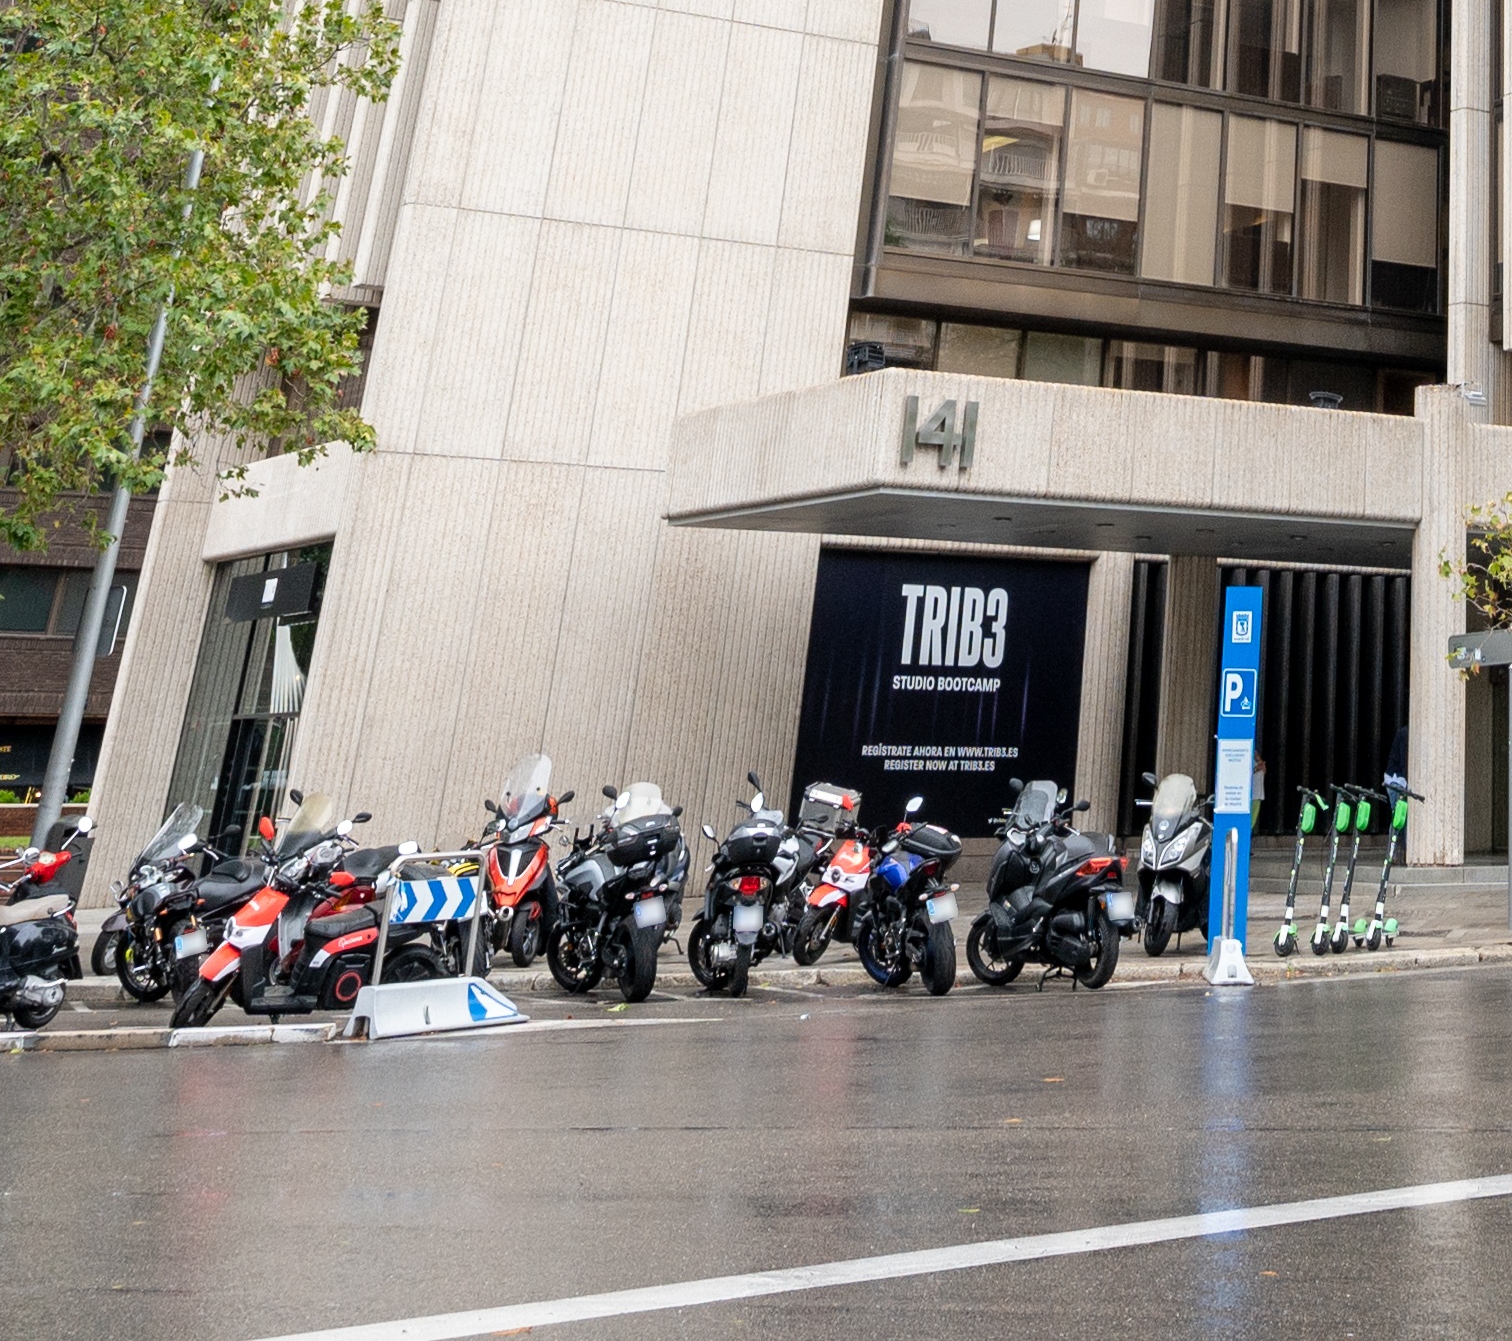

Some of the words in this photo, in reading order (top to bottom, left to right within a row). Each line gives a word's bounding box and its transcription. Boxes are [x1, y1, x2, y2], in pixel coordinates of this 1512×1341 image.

[900, 395, 980, 471] 141
[900, 583, 1009, 669] TRIB3
[892, 675, 935, 691] STUDIO
[937, 676, 1001, 693] BOOTCAMP
[1224, 672, 1244, 712] P
[883, 759, 925, 771] REGISTER
[925, 760, 947, 771] NOW
[947, 760, 958, 771] AT
[960, 760, 996, 772] TRIB3.ES
[913, 746, 943, 757] AHORA
[944, 746, 956, 758] EN
[957, 746, 1019, 759] WWW.TRIB3.ES
